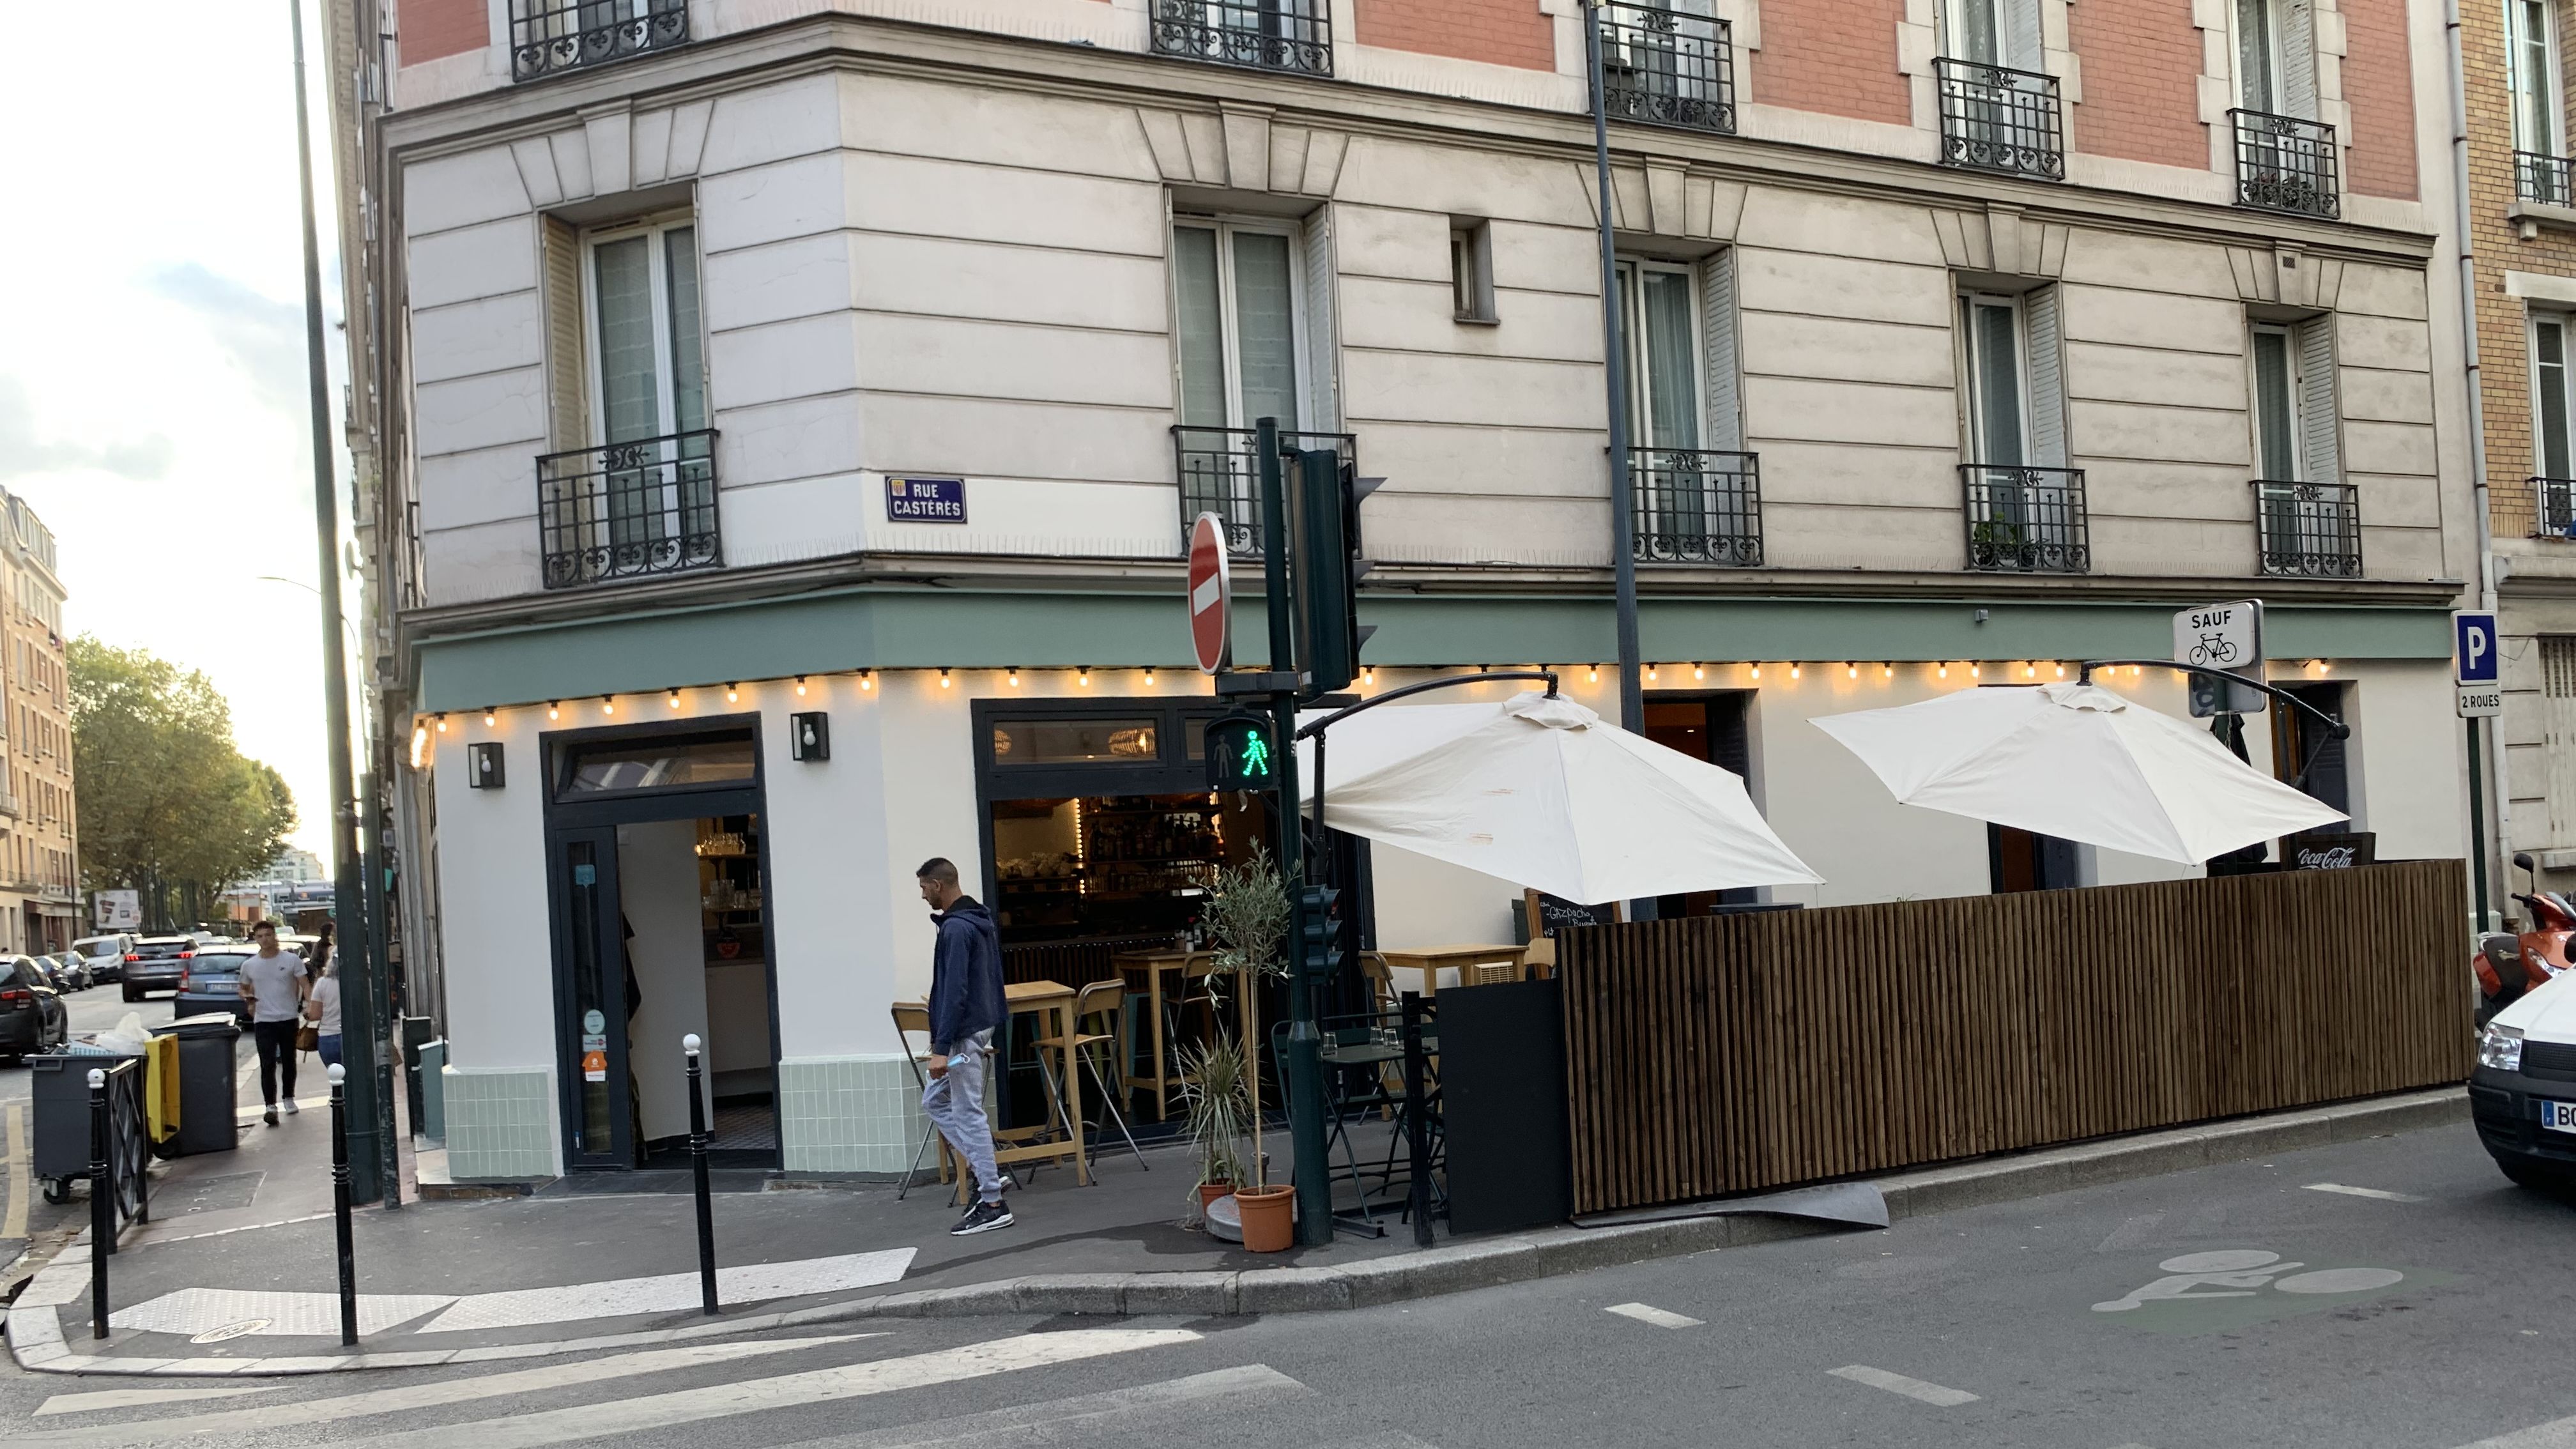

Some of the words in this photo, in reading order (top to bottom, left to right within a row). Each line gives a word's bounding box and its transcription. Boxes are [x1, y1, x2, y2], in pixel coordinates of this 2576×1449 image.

[914, 484, 939, 498] RUE
[2191, 610, 2232, 629] SAUF
[2467, 626, 2487, 670] P
[2462, 696, 2468, 708] 2
[2471, 694, 2499, 707] ROUES
